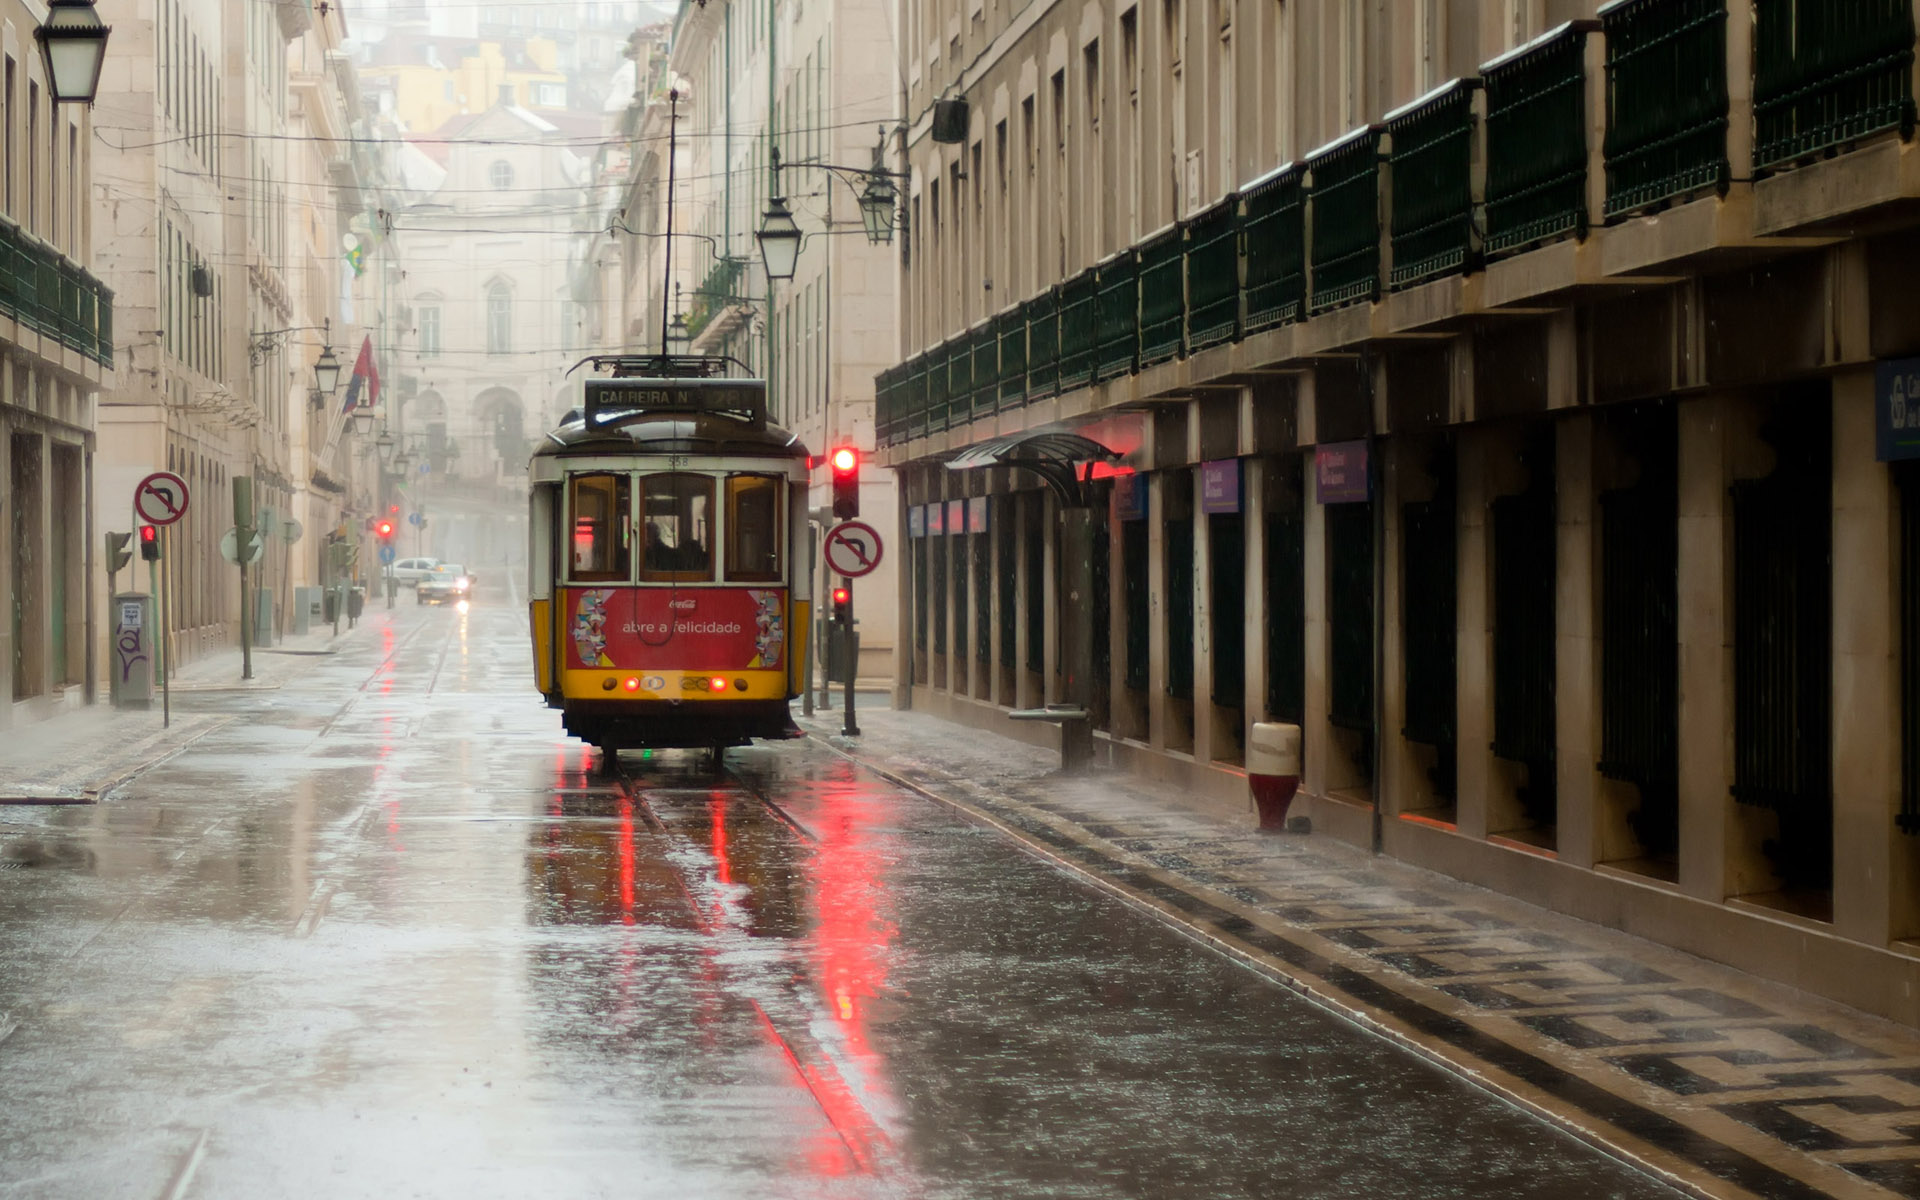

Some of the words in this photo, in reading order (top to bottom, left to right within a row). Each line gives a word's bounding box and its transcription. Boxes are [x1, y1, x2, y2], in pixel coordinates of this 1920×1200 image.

[622, 621, 655, 633] abre
[658, 623, 668, 633] a
[673, 621, 741, 633] felicidade
